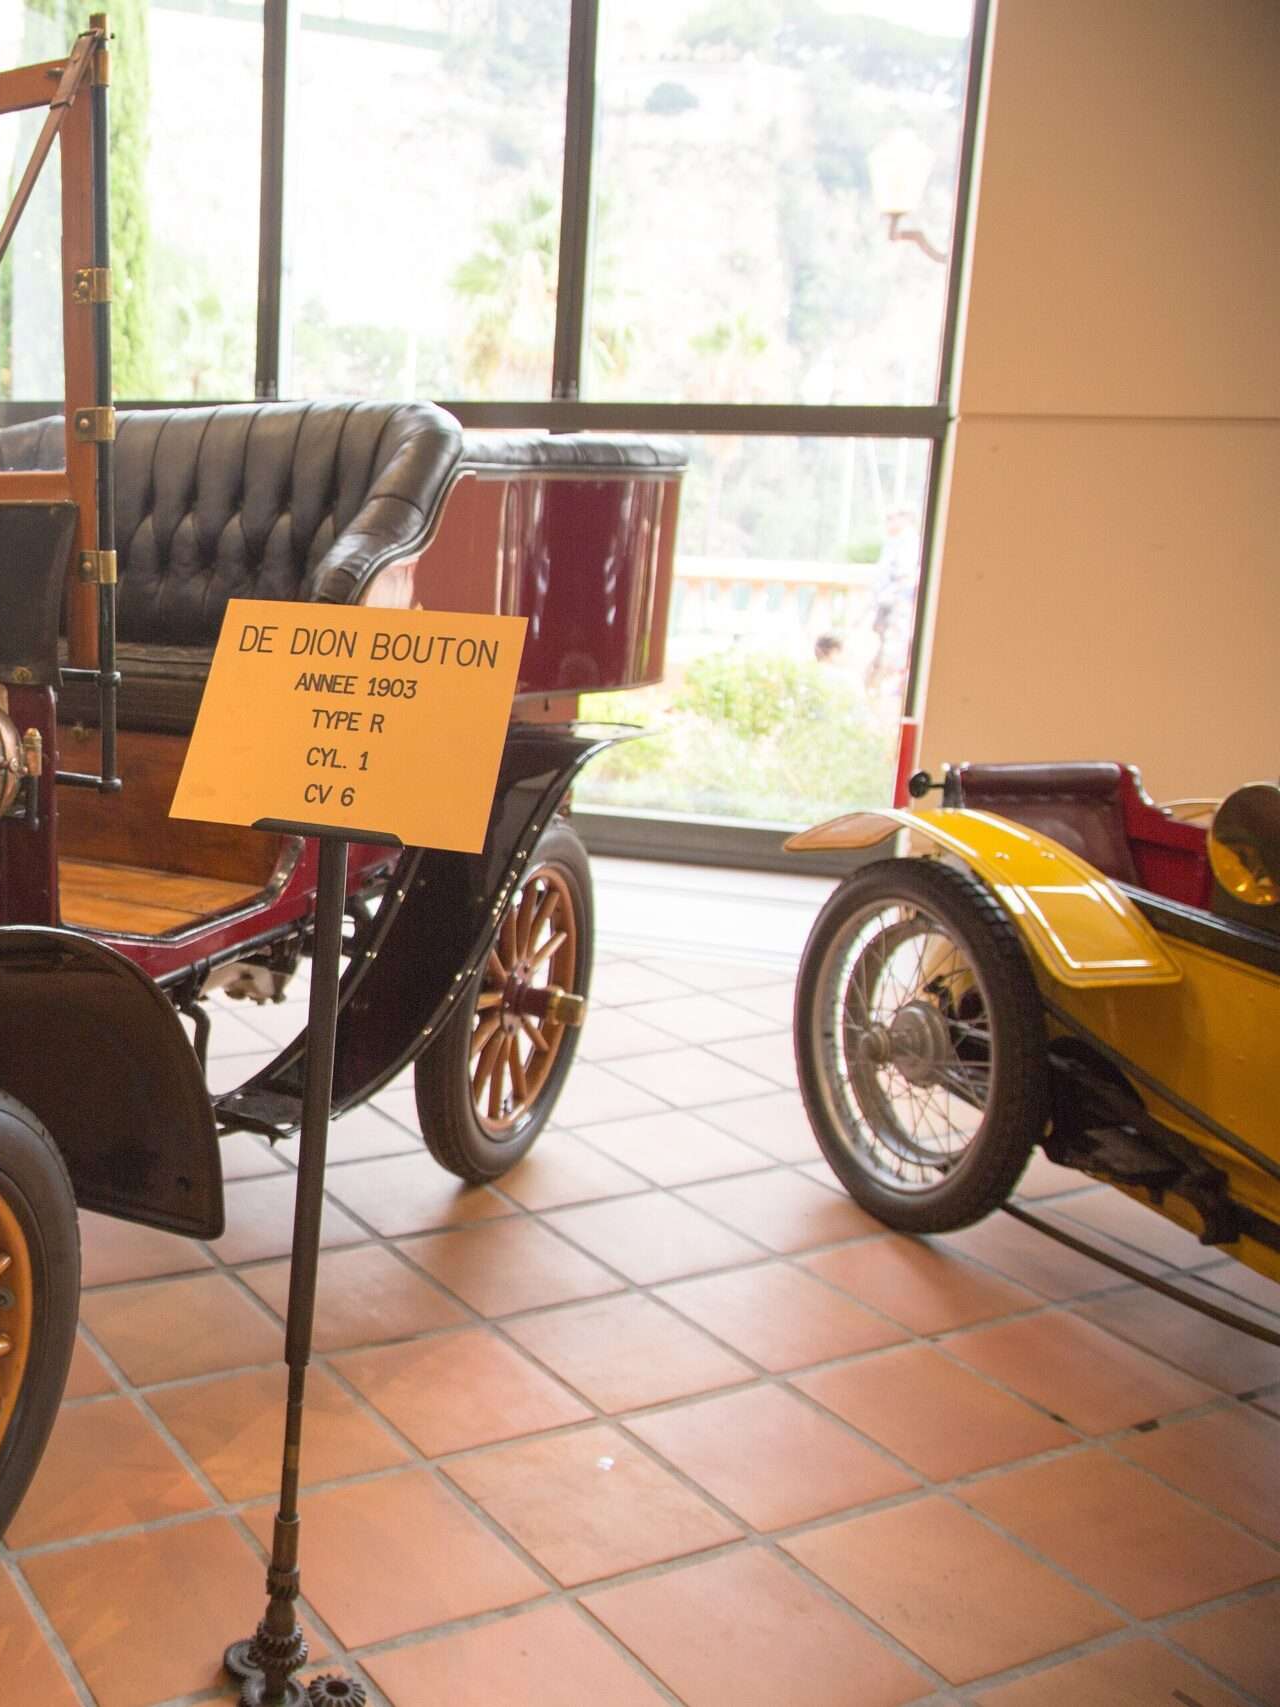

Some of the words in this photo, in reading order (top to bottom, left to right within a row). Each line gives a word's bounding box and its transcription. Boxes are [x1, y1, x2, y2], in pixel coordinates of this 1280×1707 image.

[239, 625, 278, 653] DE
[290, 628, 357, 658] DION
[371, 633, 500, 668] BOUTON
[294, 673, 358, 694] ANNEE
[368, 678, 417, 699] 1903
[312, 709, 362, 731] TYPE
[370, 714, 384, 733] R
[307, 747, 346, 768] CYL.
[359, 752, 368, 771] 1
[305, 784, 333, 804] CV
[341, 787, 355, 806] 6
